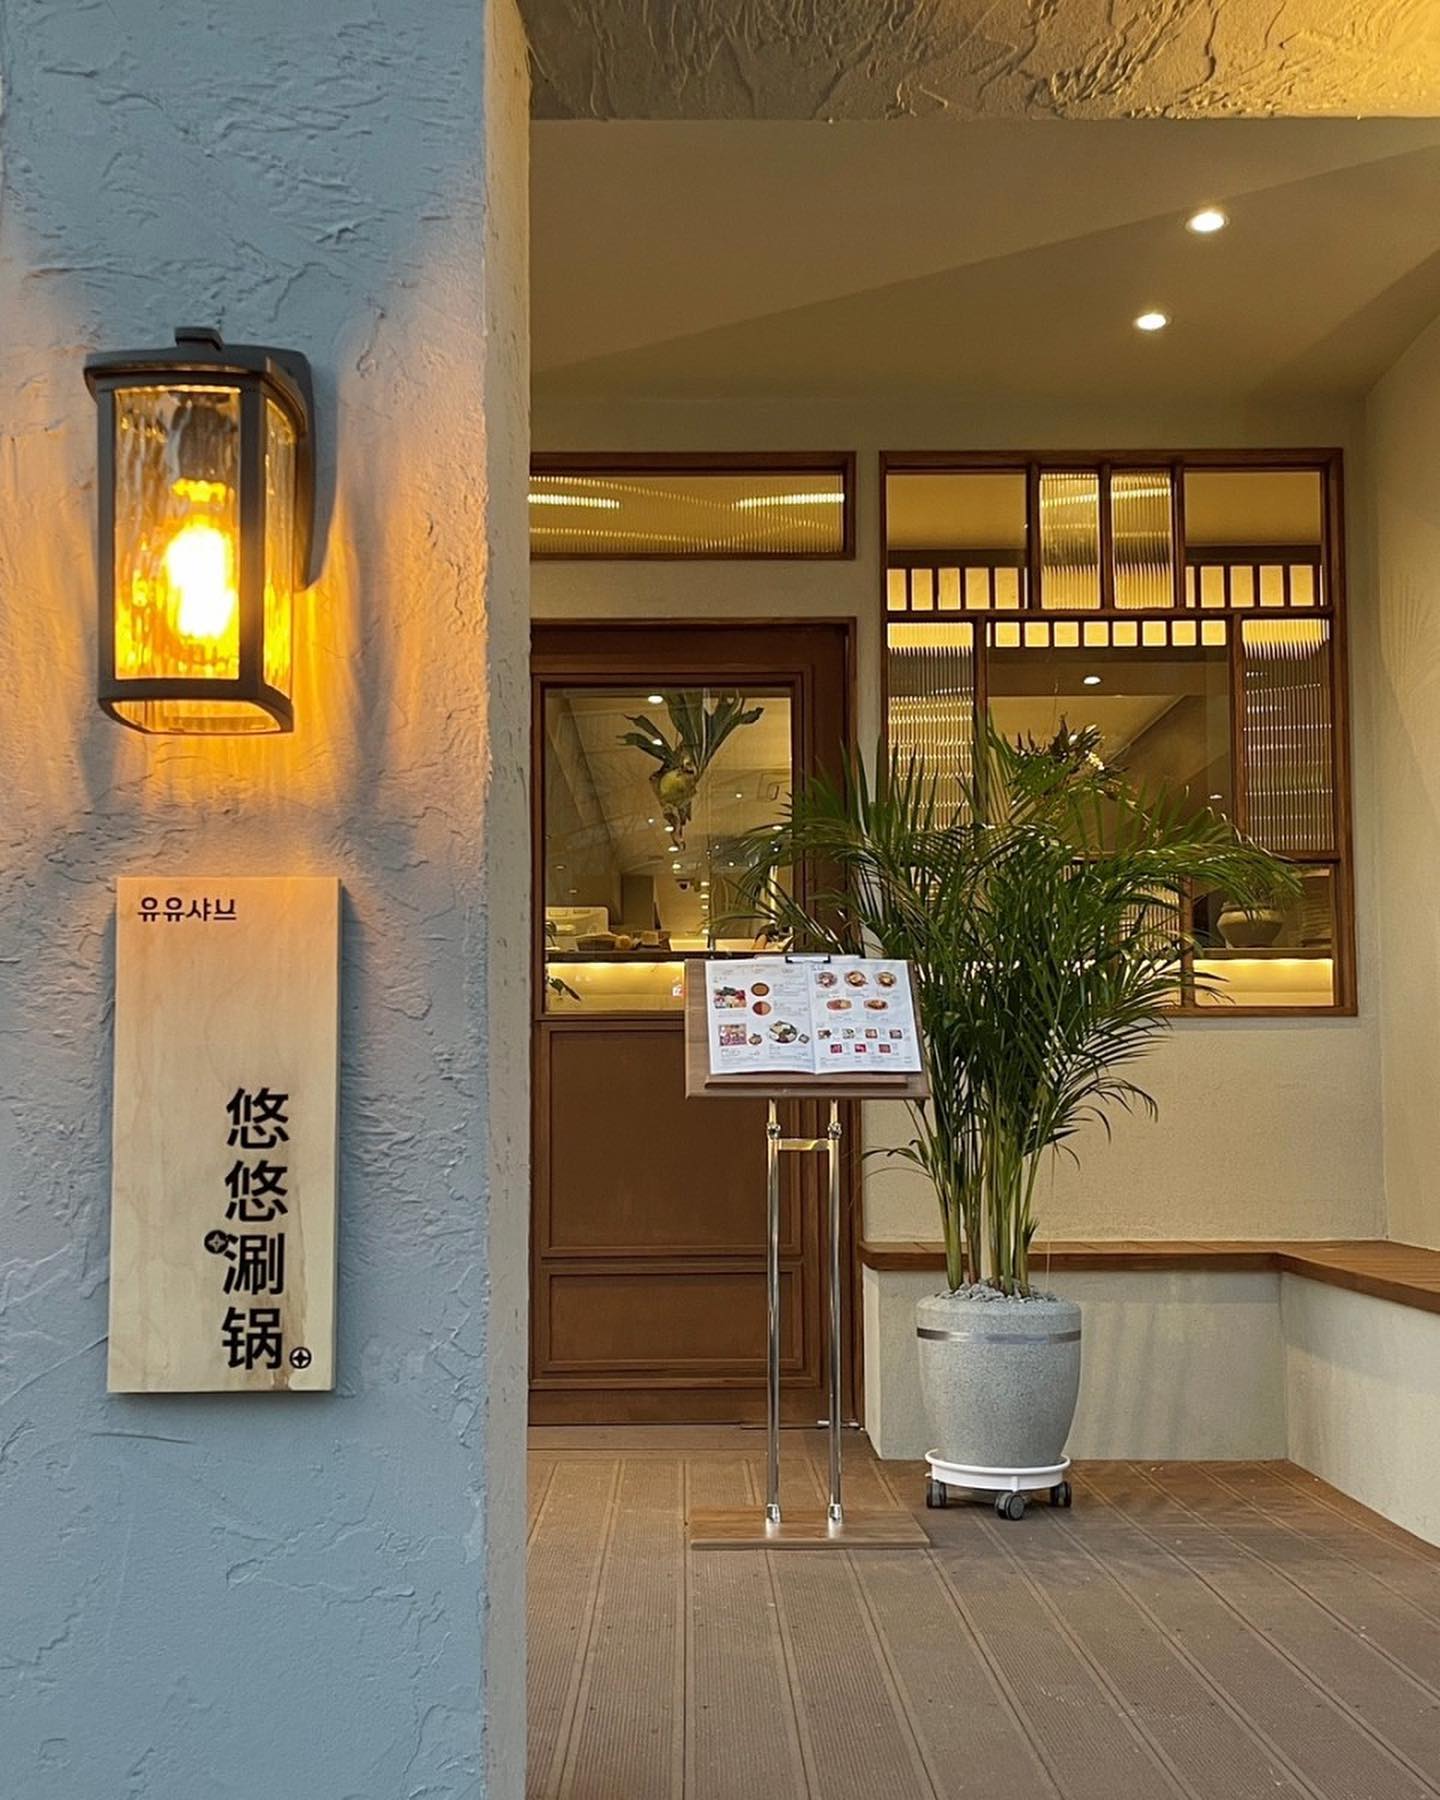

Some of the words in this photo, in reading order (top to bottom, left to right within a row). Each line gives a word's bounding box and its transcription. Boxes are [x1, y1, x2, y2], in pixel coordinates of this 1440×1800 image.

[137, 896, 237, 922] 유유샤브
[222, 1087, 290, 1370] 悠悠涮锅
